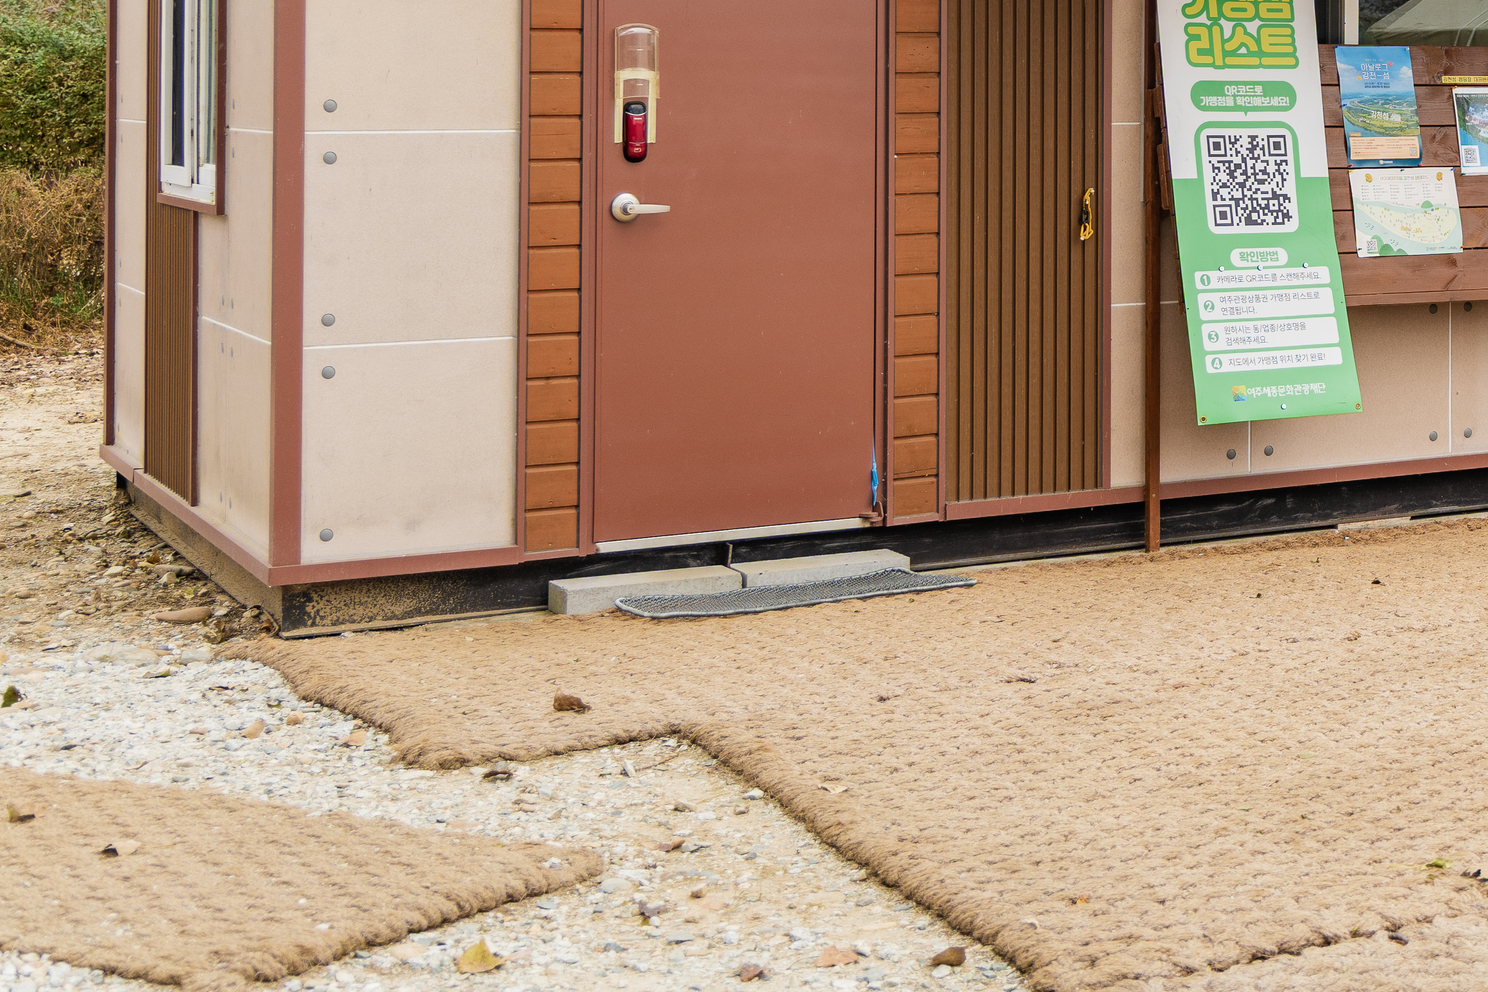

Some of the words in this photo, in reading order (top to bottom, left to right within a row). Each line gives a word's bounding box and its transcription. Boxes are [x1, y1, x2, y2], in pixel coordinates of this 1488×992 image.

[1187, 24, 1297, 66] 리스트
[1224, 85, 1264, 96] QR코드로
[1200, 96, 1234, 107] 가맹점을
[1236, 96, 1290, 106] 확인해보세요!
[1238, 250, 1280, 263] 확인방법
[1216, 274, 1244, 284] 카메라로
[1246, 273, 1278, 283] QR코드를
[1279, 271, 1322, 282] 스캔해주세요.
[1219, 294, 1268, 304] 여주관광상품권
[1270, 292, 1291, 302] 가맹점
[1292, 290, 1320, 300] 리스트로
[1220, 306, 1258, 316] 연결됩니다.
[1224, 324, 1252, 334] 원하시는
[1252, 322, 1307, 334] 동/업종/상호명을
[1225, 336, 1268, 346] 검색해주세요.
[1228, 358, 1256, 367] 지도에서
[1257, 356, 1278, 366] 가맹점
[1280, 354, 1294, 364] 위치
[1294, 354, 1309, 363] 찾기
[1310, 352, 1326, 362] 완료!
[1246, 382, 1326, 398] 여주세종문화관광재단
